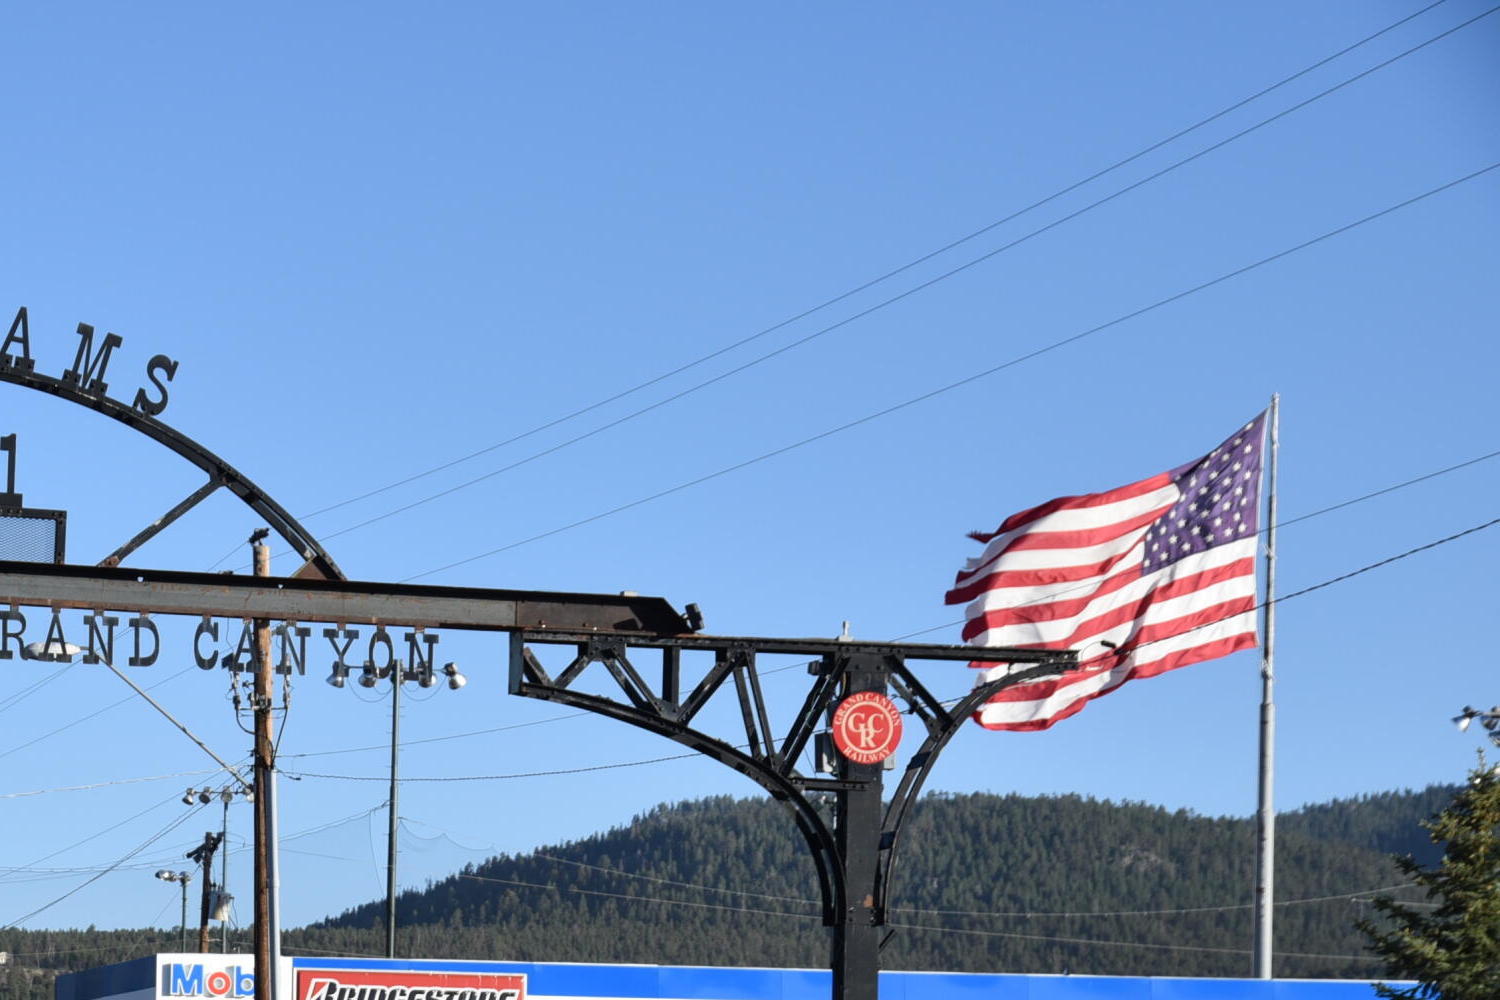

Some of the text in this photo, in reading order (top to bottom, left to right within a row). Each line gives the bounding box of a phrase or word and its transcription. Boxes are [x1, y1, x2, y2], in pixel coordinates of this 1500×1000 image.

[194, 618, 439, 682] CANYON
[834, 693, 901, 726] GRAND CANYON
[843, 745, 891, 763] RAILWAY
